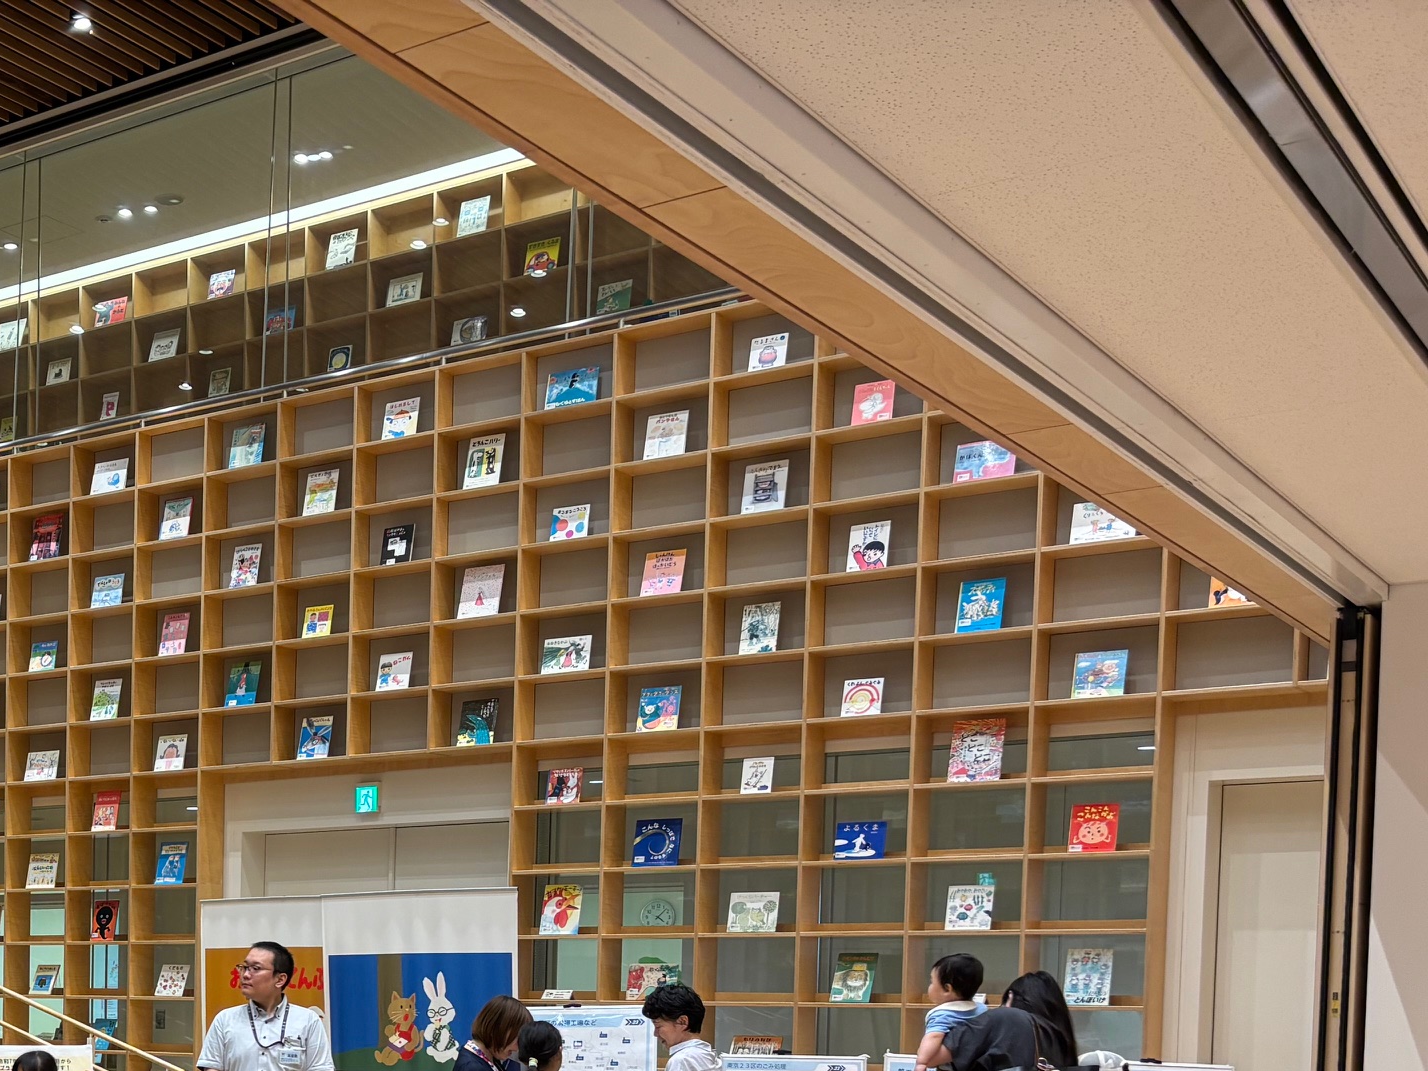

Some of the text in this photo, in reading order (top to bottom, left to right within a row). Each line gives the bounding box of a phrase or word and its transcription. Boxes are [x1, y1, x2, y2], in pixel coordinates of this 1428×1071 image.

[390, 400, 415, 409] はじめまして
[472, 438, 501, 447] どろんこハリー
[959, 453, 982, 461] かばくん
[642, 822, 660, 832] こんな
